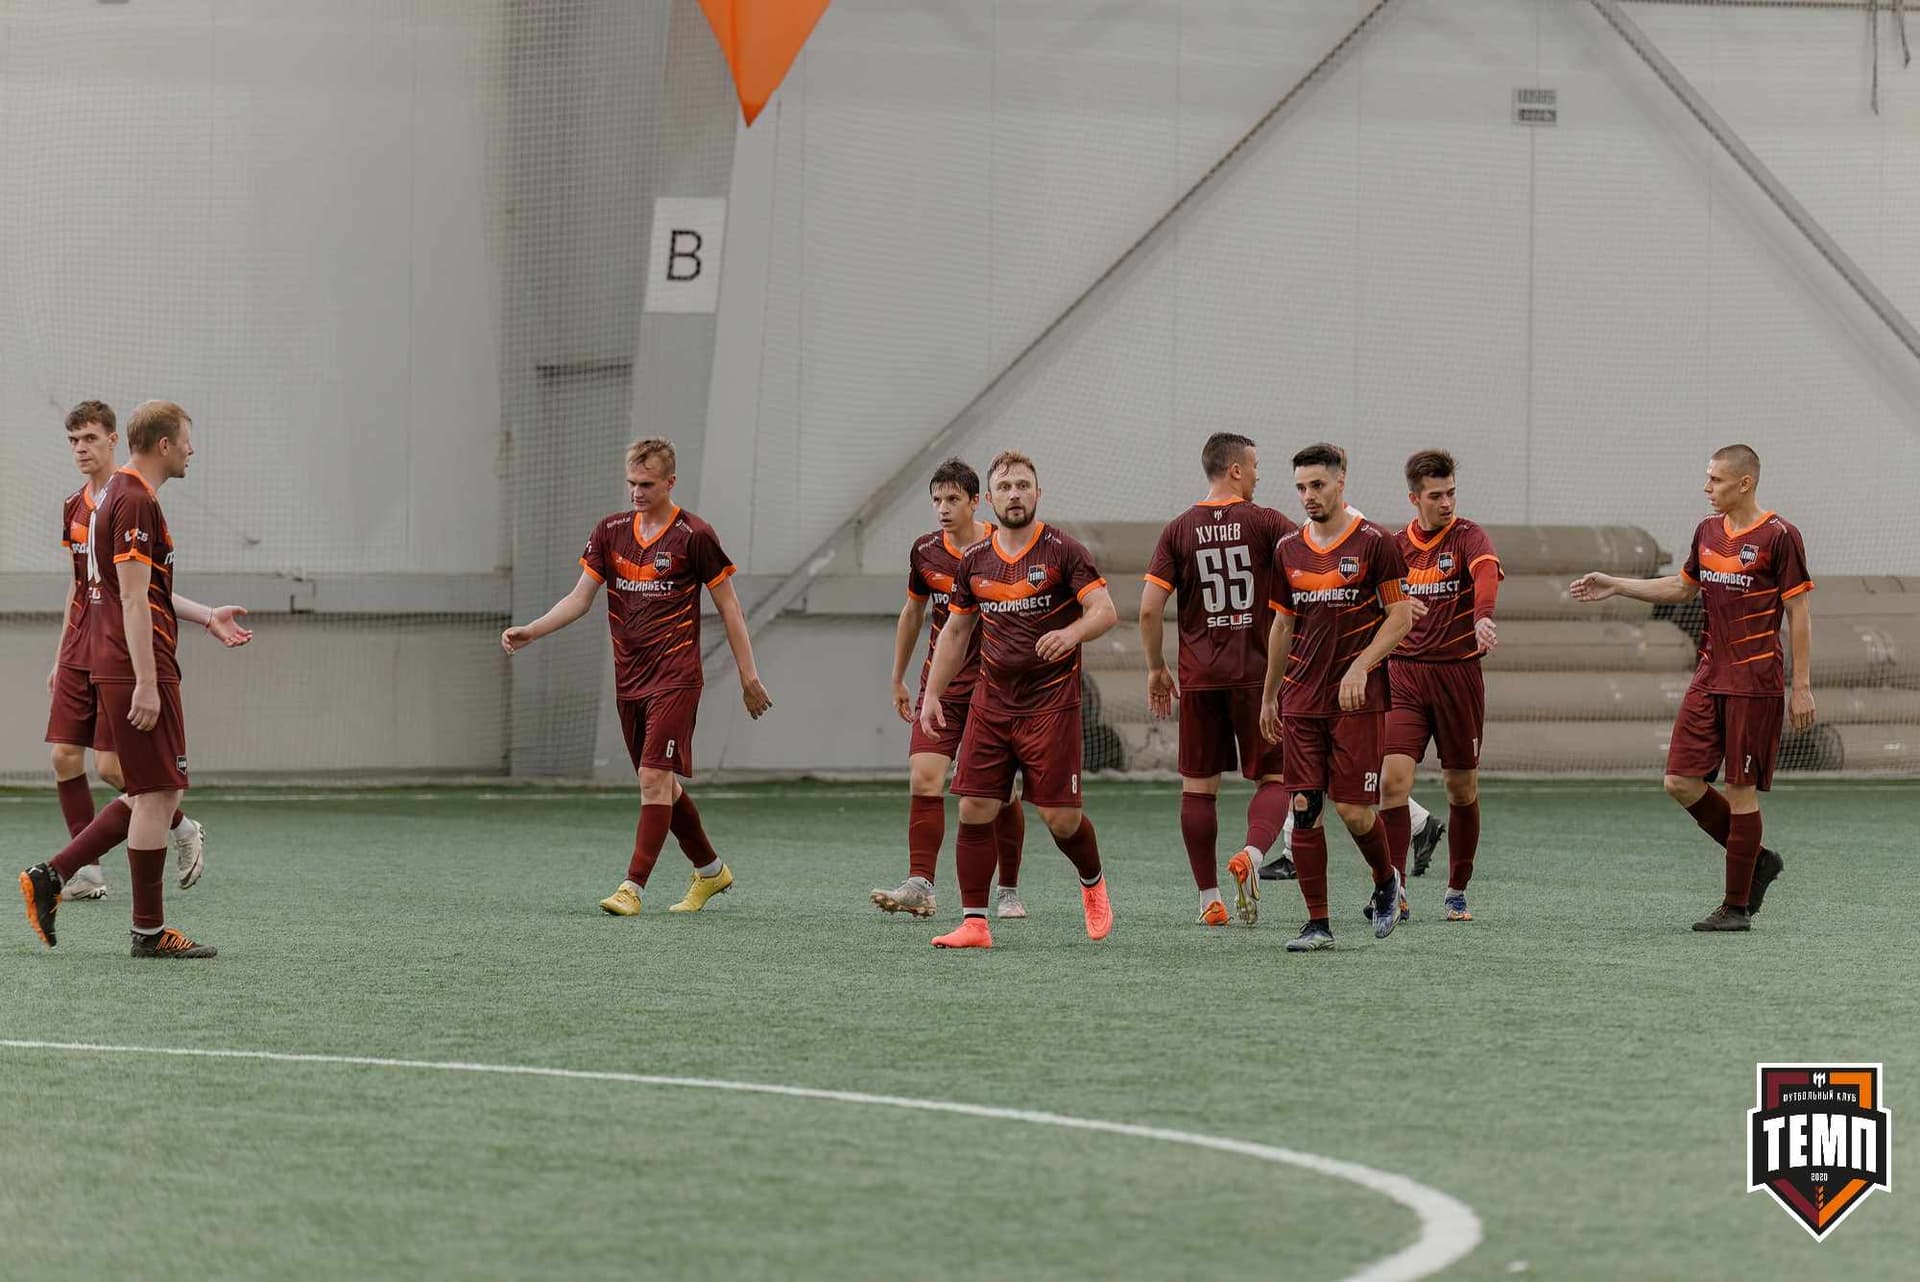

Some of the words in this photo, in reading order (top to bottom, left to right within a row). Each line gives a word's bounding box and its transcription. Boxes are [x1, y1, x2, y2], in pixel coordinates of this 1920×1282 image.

[667, 229, 702, 281] B
[1196, 545, 1255, 613] 55
[665, 739, 676, 758] 6
[1071, 774, 1078, 794] 8
[1364, 772, 1378, 792] 23
